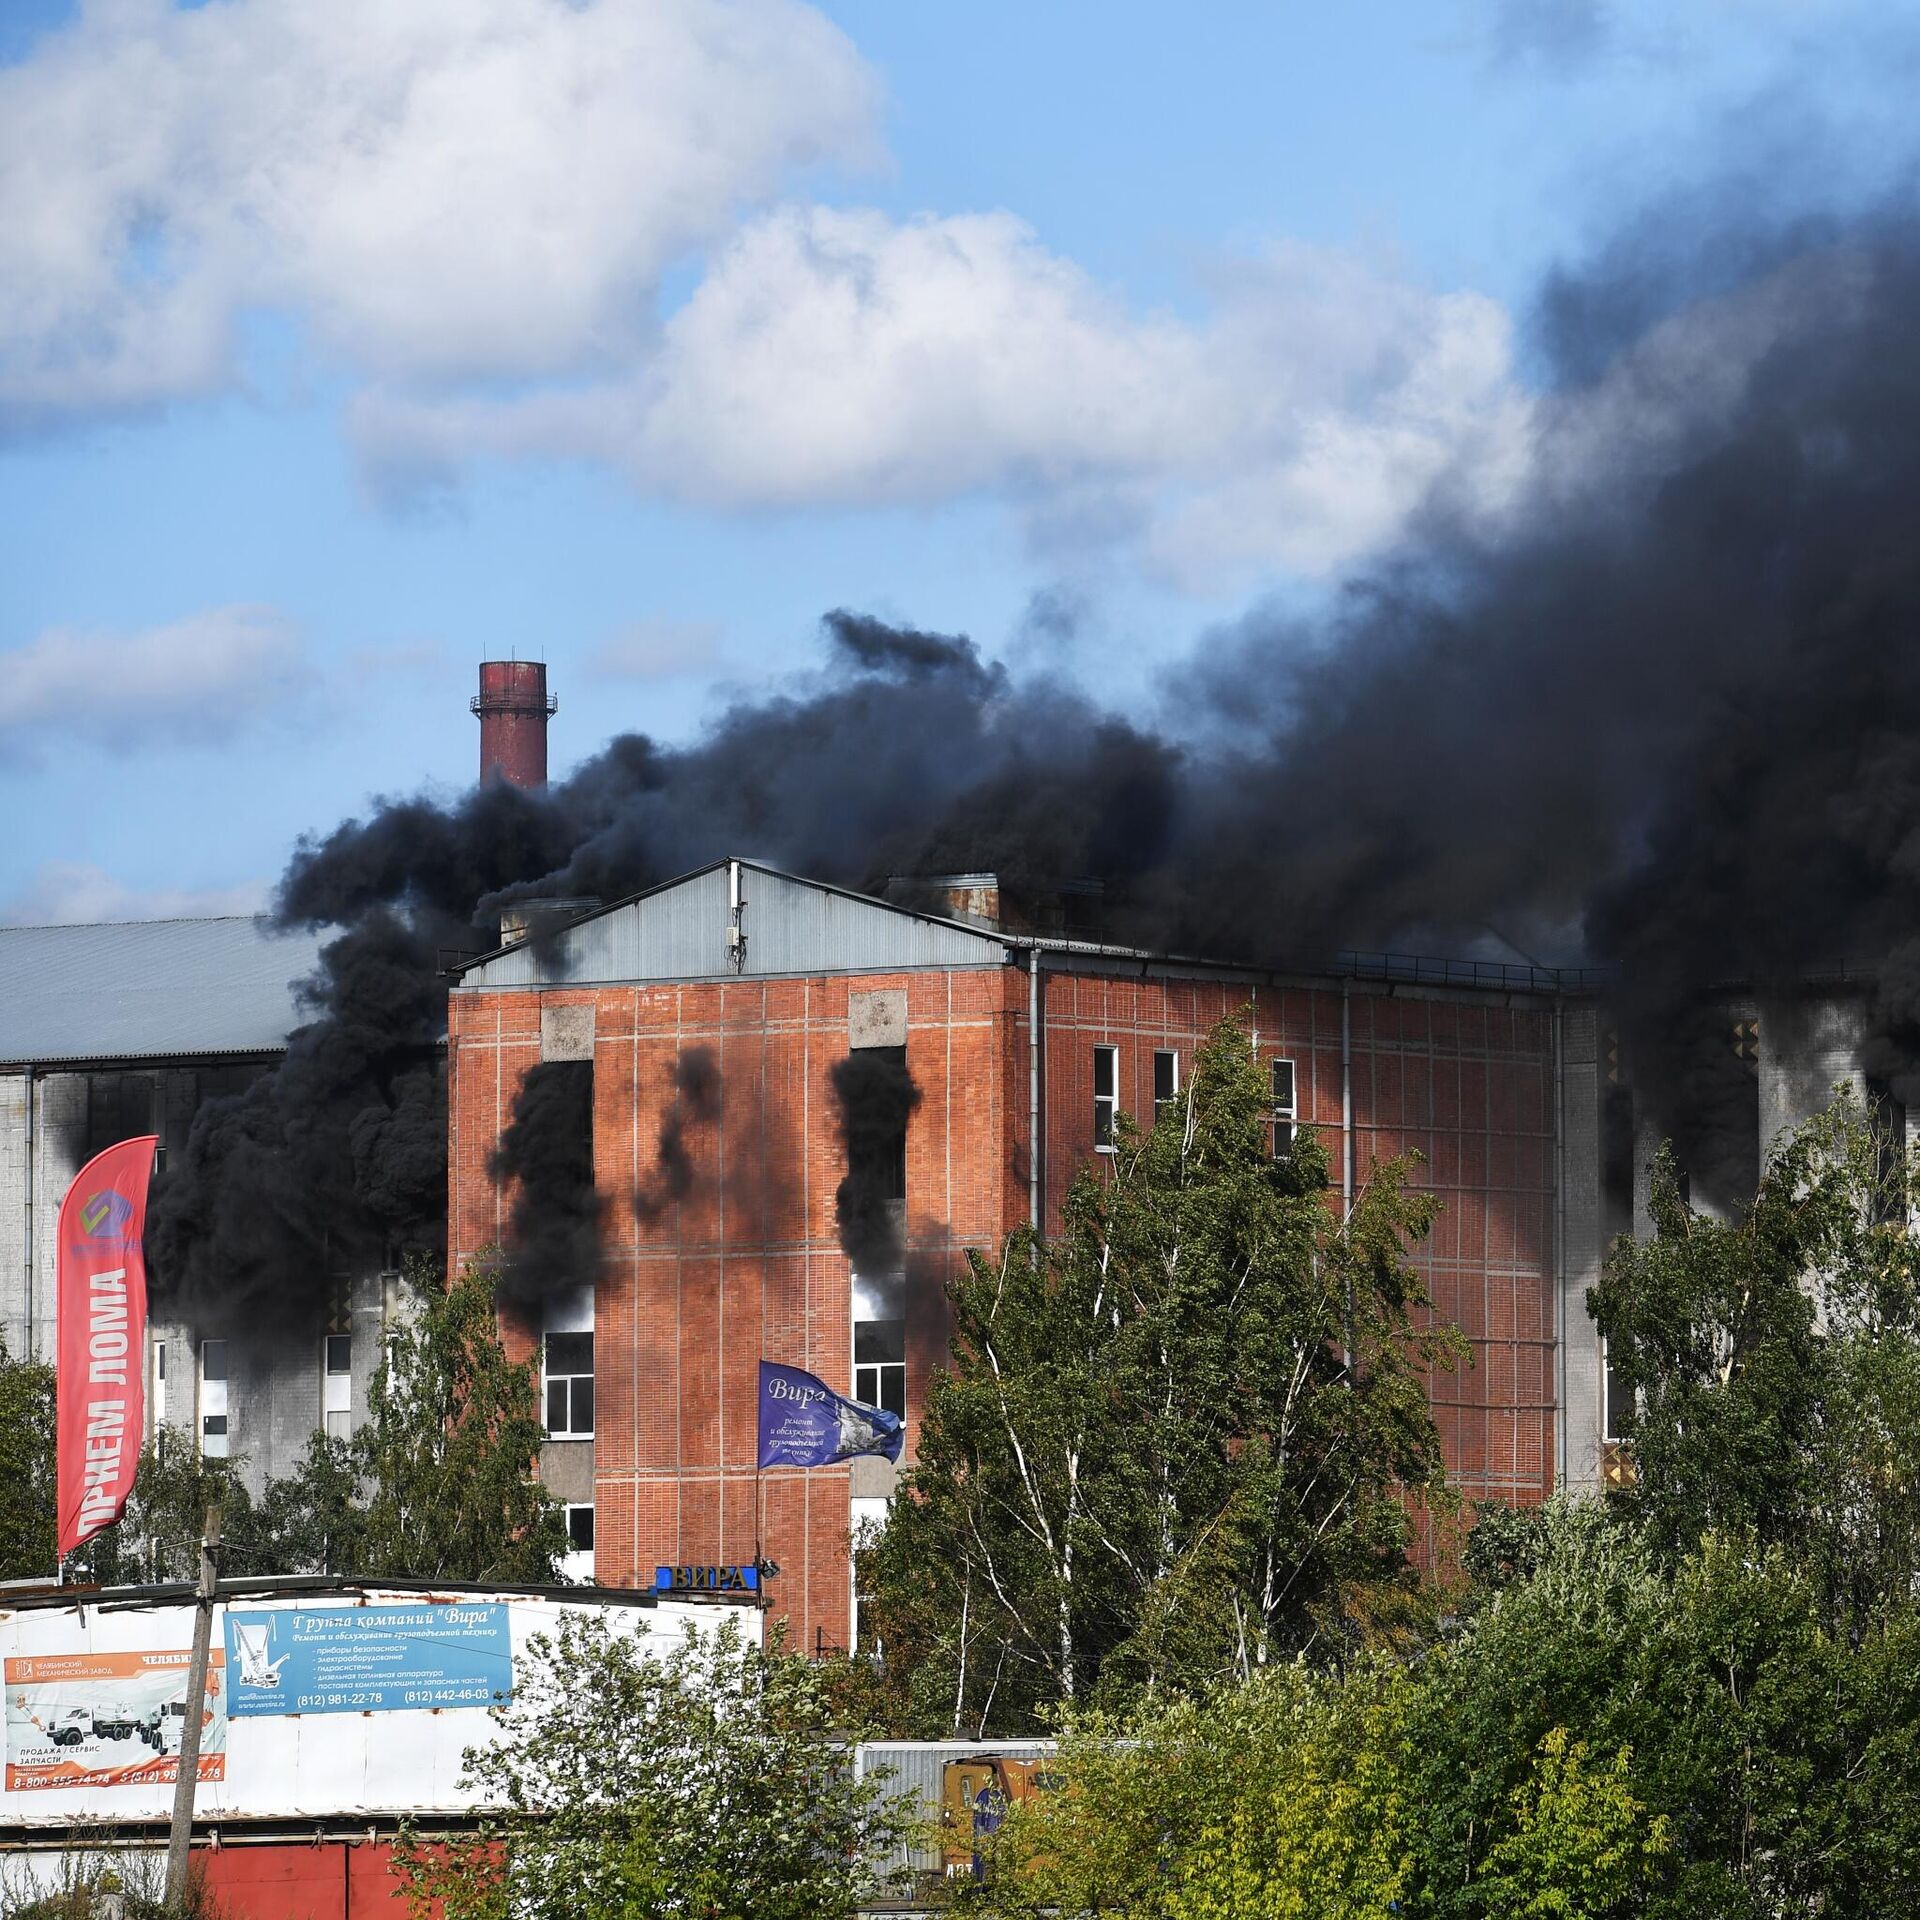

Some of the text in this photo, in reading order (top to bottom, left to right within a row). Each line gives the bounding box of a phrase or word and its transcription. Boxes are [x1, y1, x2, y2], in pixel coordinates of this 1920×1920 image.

[89, 1268, 129, 1385] ЛОМА
[77, 1400, 126, 1536] ПРИЕМ
[670, 1566, 748, 1588] ВИРА
[293, 1607, 496, 1632] Группа компаний "Вира"
[292, 1633, 326, 1642] Ремонт
[335, 1631, 393, 1642] обслуживание
[462, 1628, 497, 1637] техники
[316, 1645, 407, 1655] приборы безопасности
[318, 1655, 403, 1663] электрооборудование
[317, 1664, 373, 1673] гидросистемы
[317, 1672, 356, 1681] дизельная
[396, 1670, 444, 1679] аппаратура
[318, 1682, 353, 1690] поставка
[461, 1676, 488, 1684] частей
[297, 1692, 383, 1708] (812) 981-22-78
[404, 1688, 489, 1704] (812) 442-46-03
[20, 1747, 61, 1756] ПРОДАЖА
[69, 1745, 101, 1753] СЕРВИС
[20, 1757, 61, 1765] ЗАПЧАСТИ
[163, 1768, 221, 1780] 982-78
